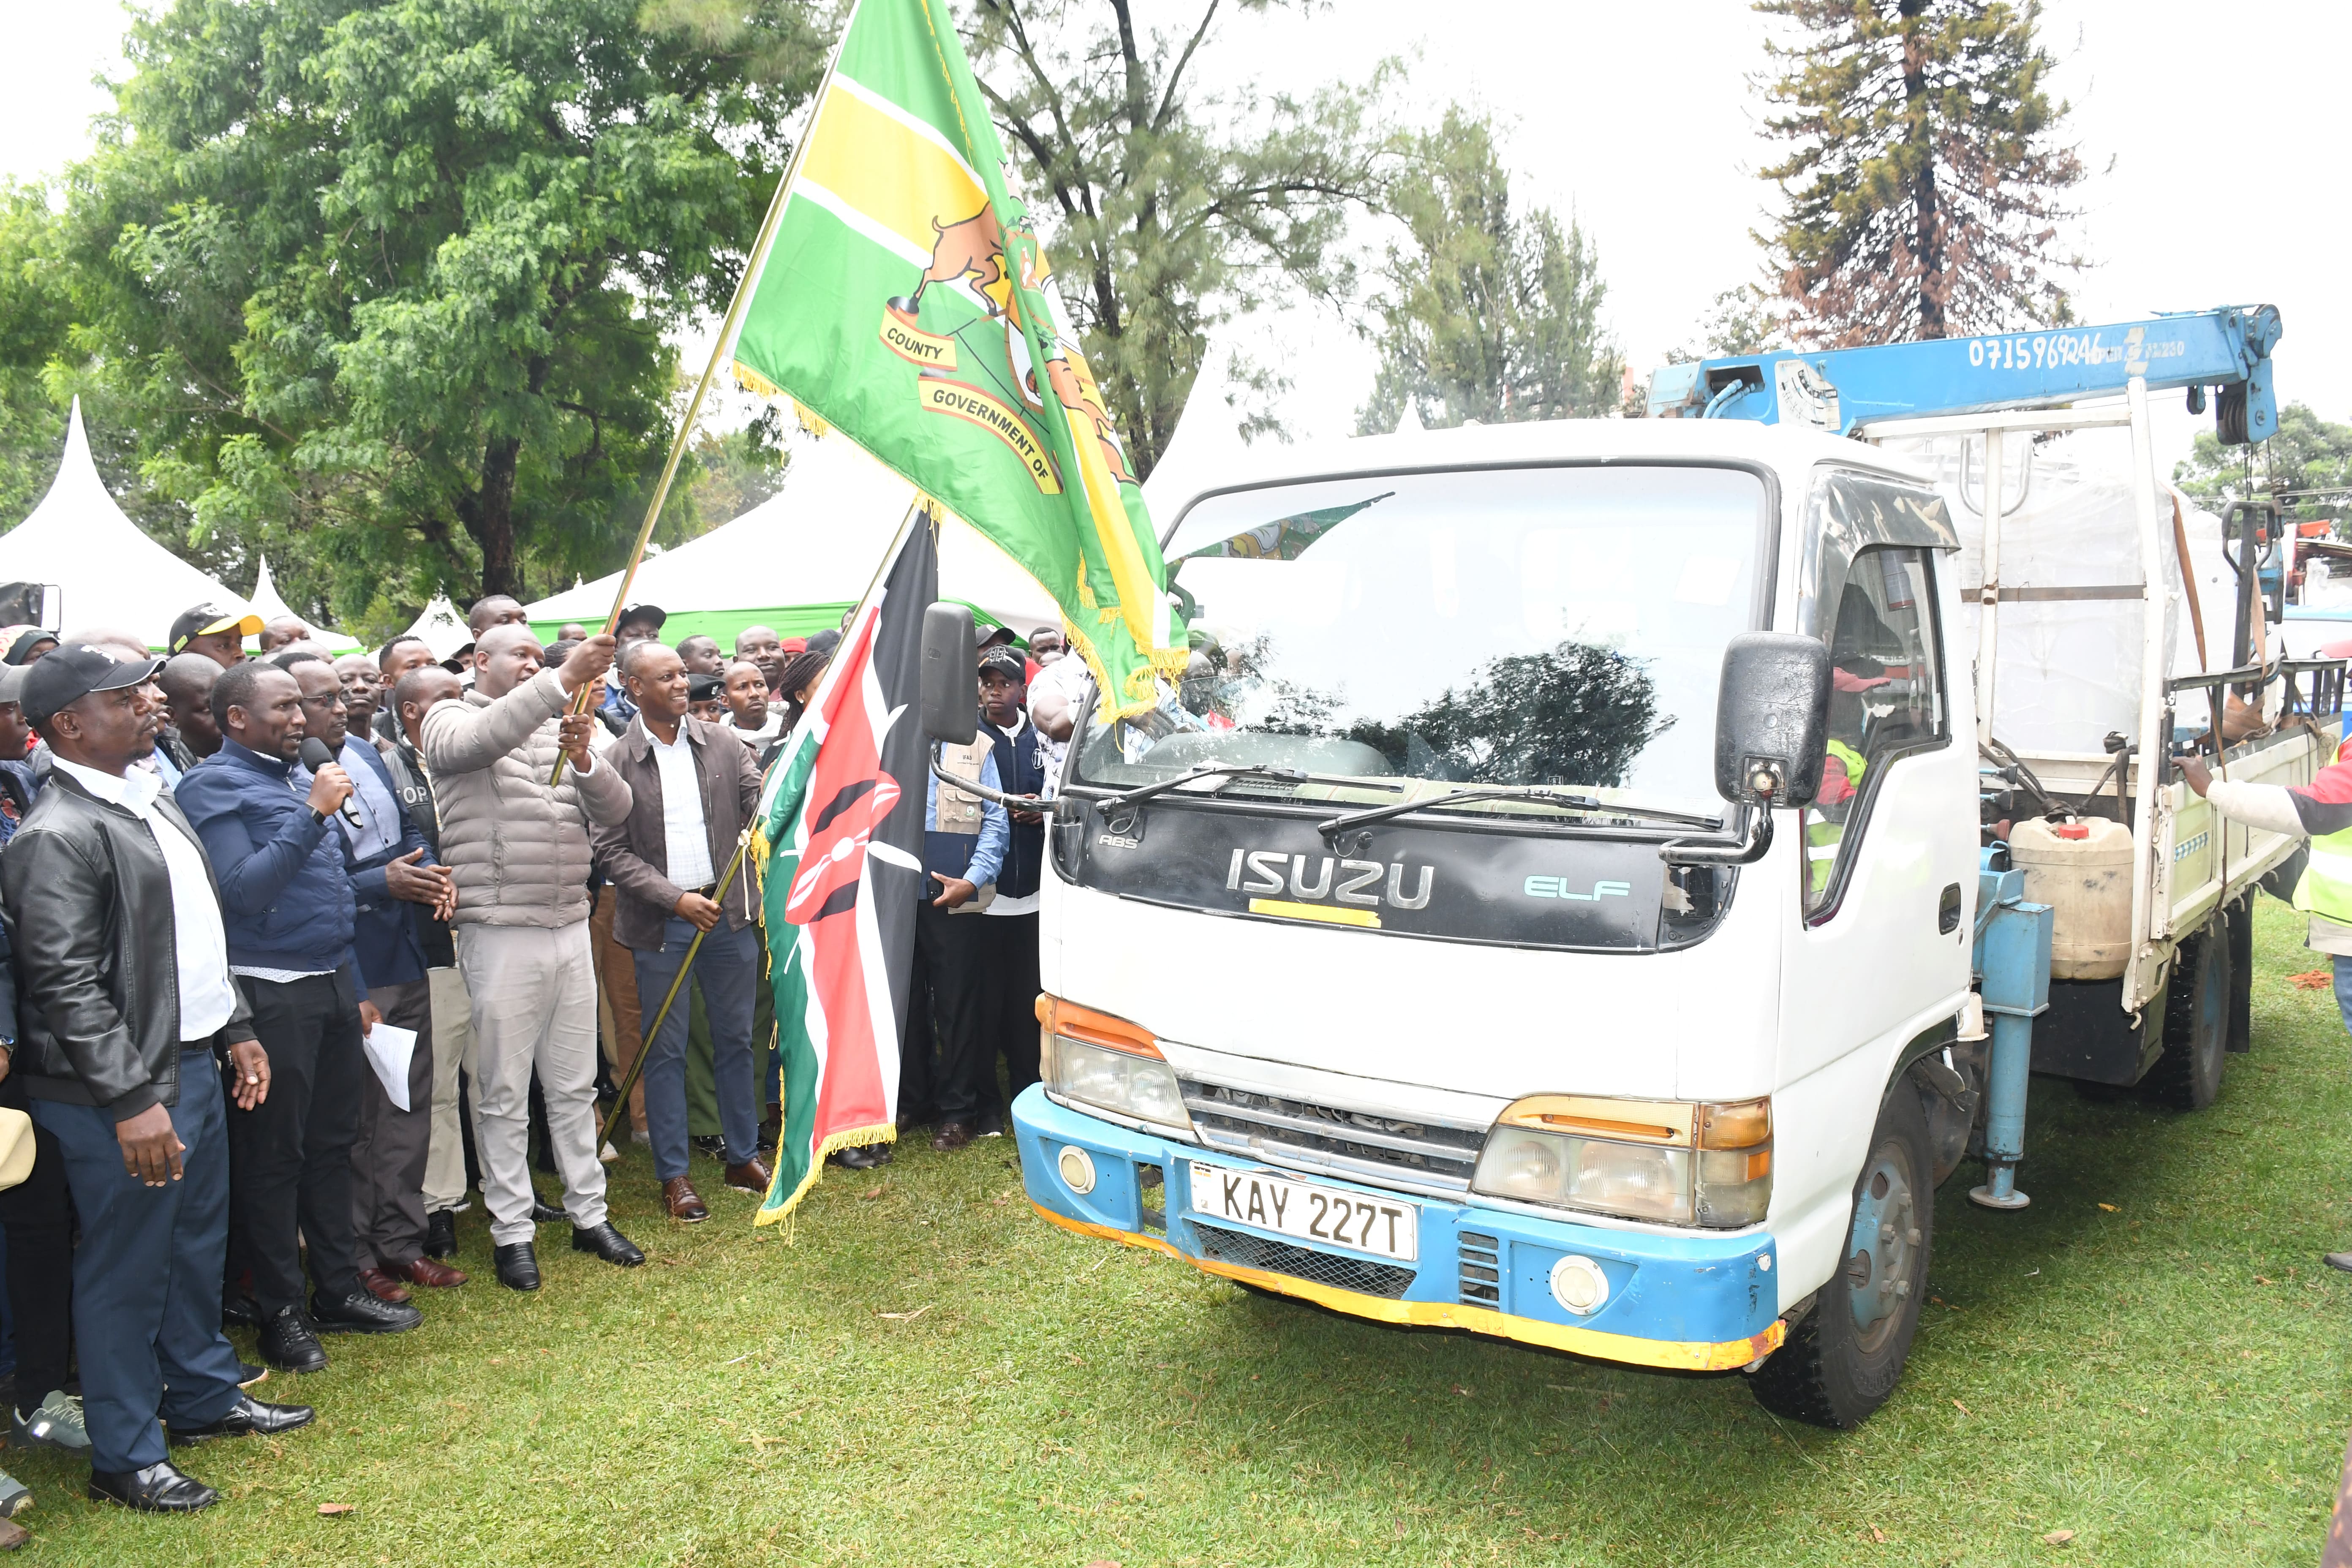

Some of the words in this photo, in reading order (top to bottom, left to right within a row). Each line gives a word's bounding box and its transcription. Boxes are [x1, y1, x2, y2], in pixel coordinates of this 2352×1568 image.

[887, 328, 944, 359] COUNTY
[933, 389, 1035, 457] GOVERNMENT
[1033, 459, 1048, 479] OF
[396, 786, 427, 803] OP
[1098, 834, 1138, 849] ABS
[1226, 849, 1434, 910] ISUZU
[1524, 875, 1631, 901] ELF
[1223, 1173, 1289, 1228] KAY
[1310, 1192, 1403, 1253] 227T
